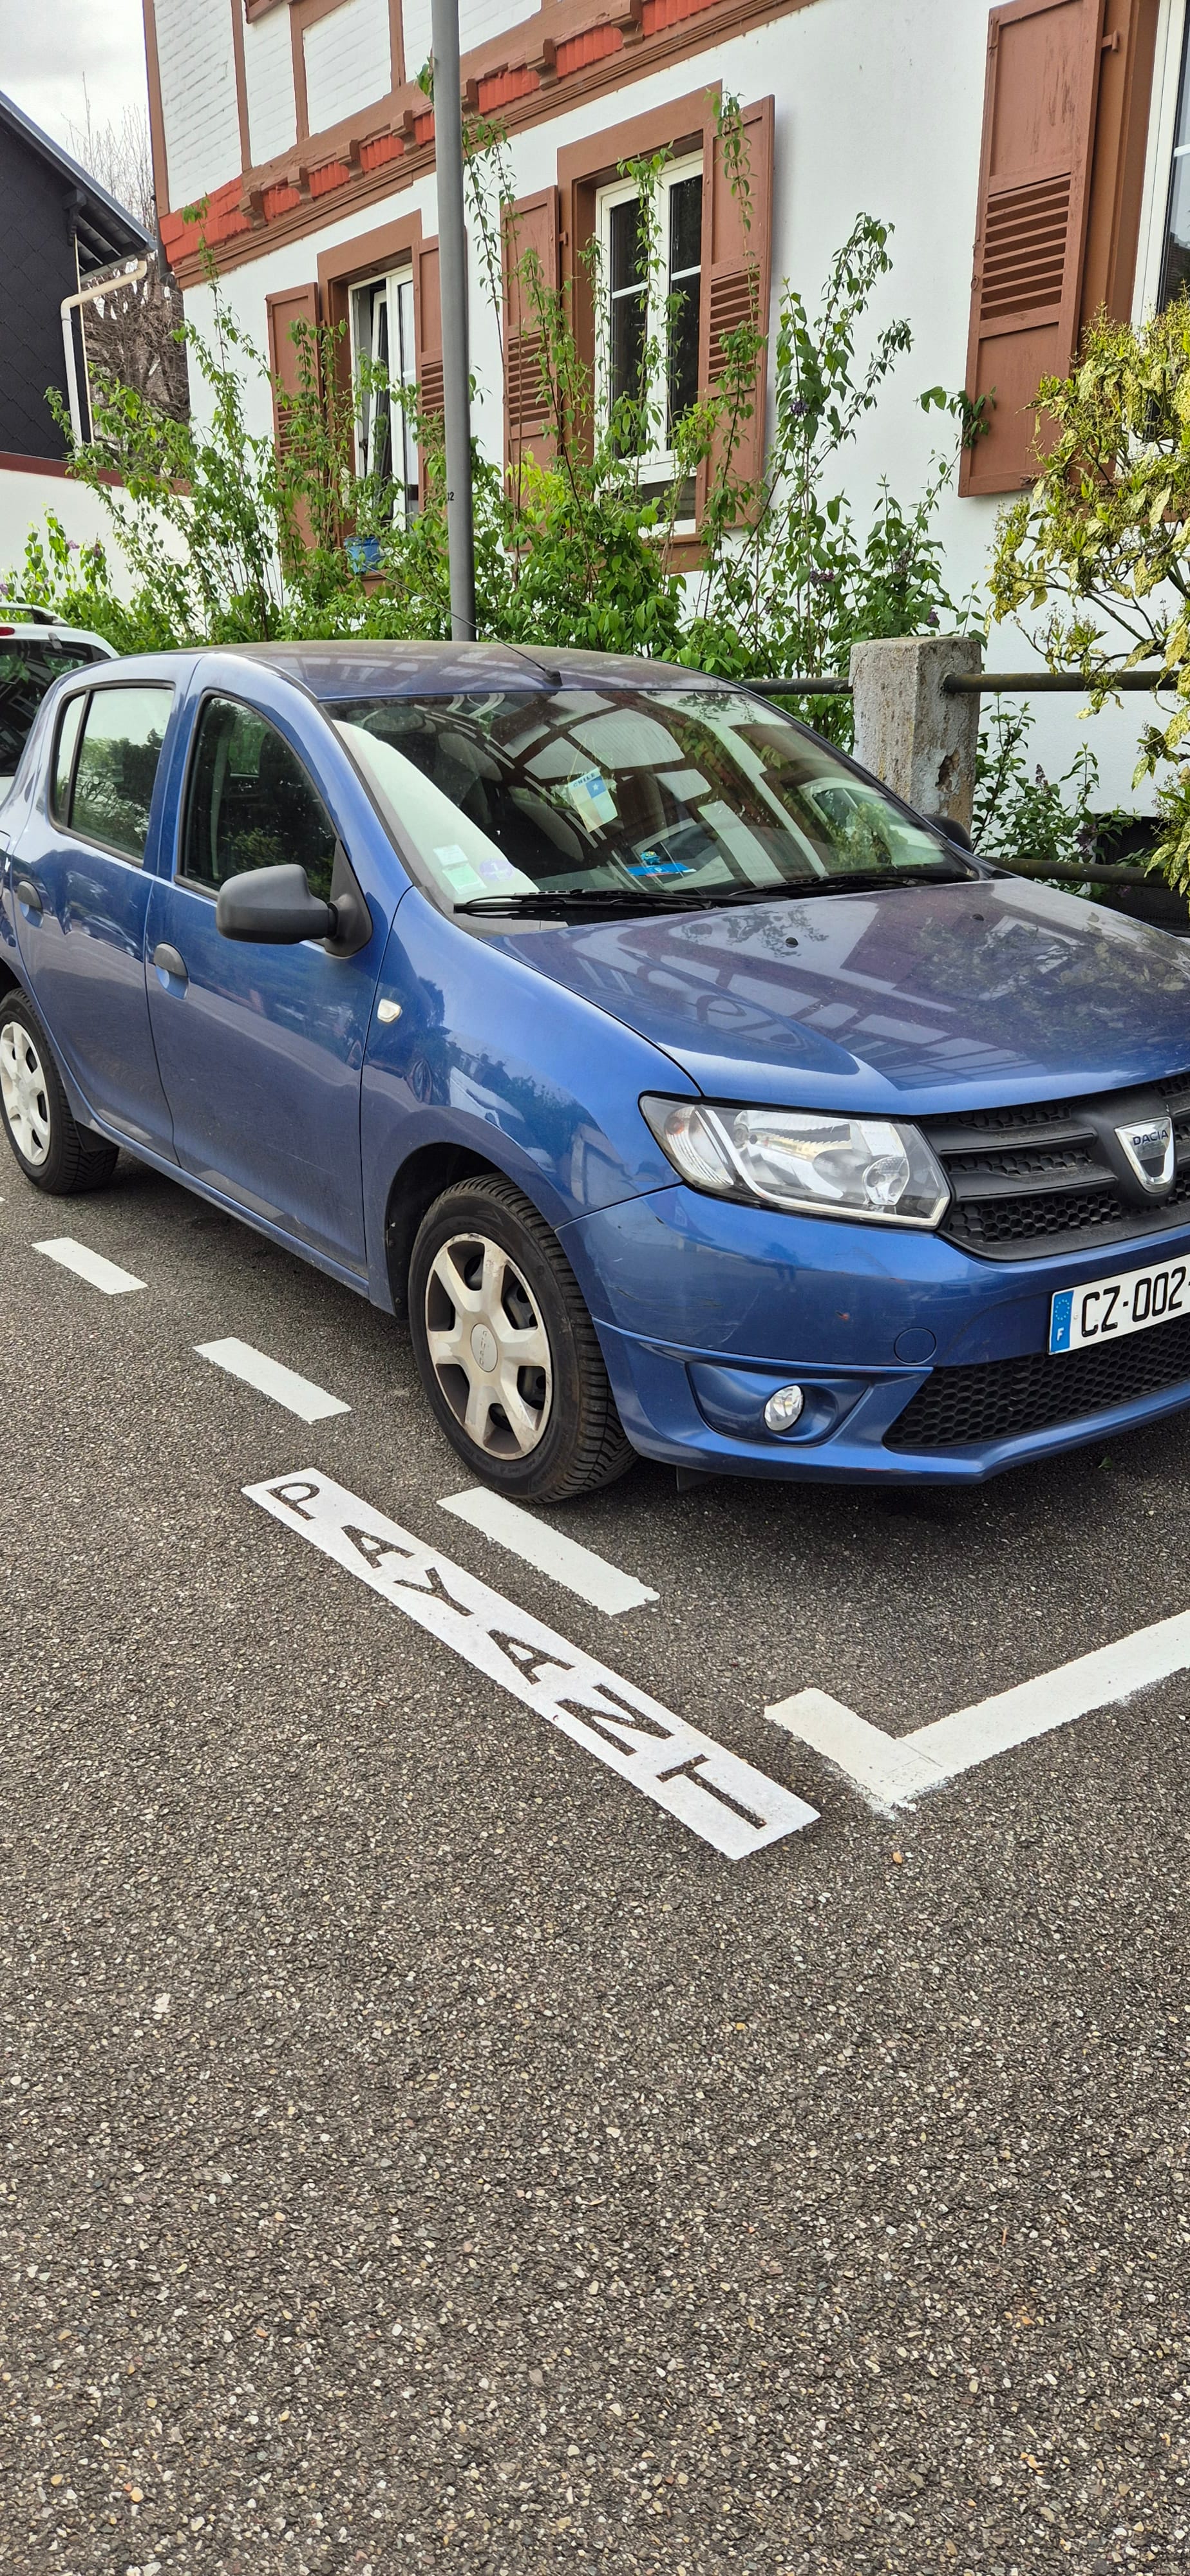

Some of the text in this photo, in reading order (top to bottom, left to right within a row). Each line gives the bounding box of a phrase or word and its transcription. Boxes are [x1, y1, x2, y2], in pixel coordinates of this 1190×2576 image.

[448, 491, 455, 501] 2
[573, 772, 596, 788] CHILE
[1133, 1129, 1169, 1146] DACIA
[1081, 1266, 1190, 1338] CZ-002
[1057, 1327, 1064, 1341] F
[265, 1482, 768, 1830] PAYANT
